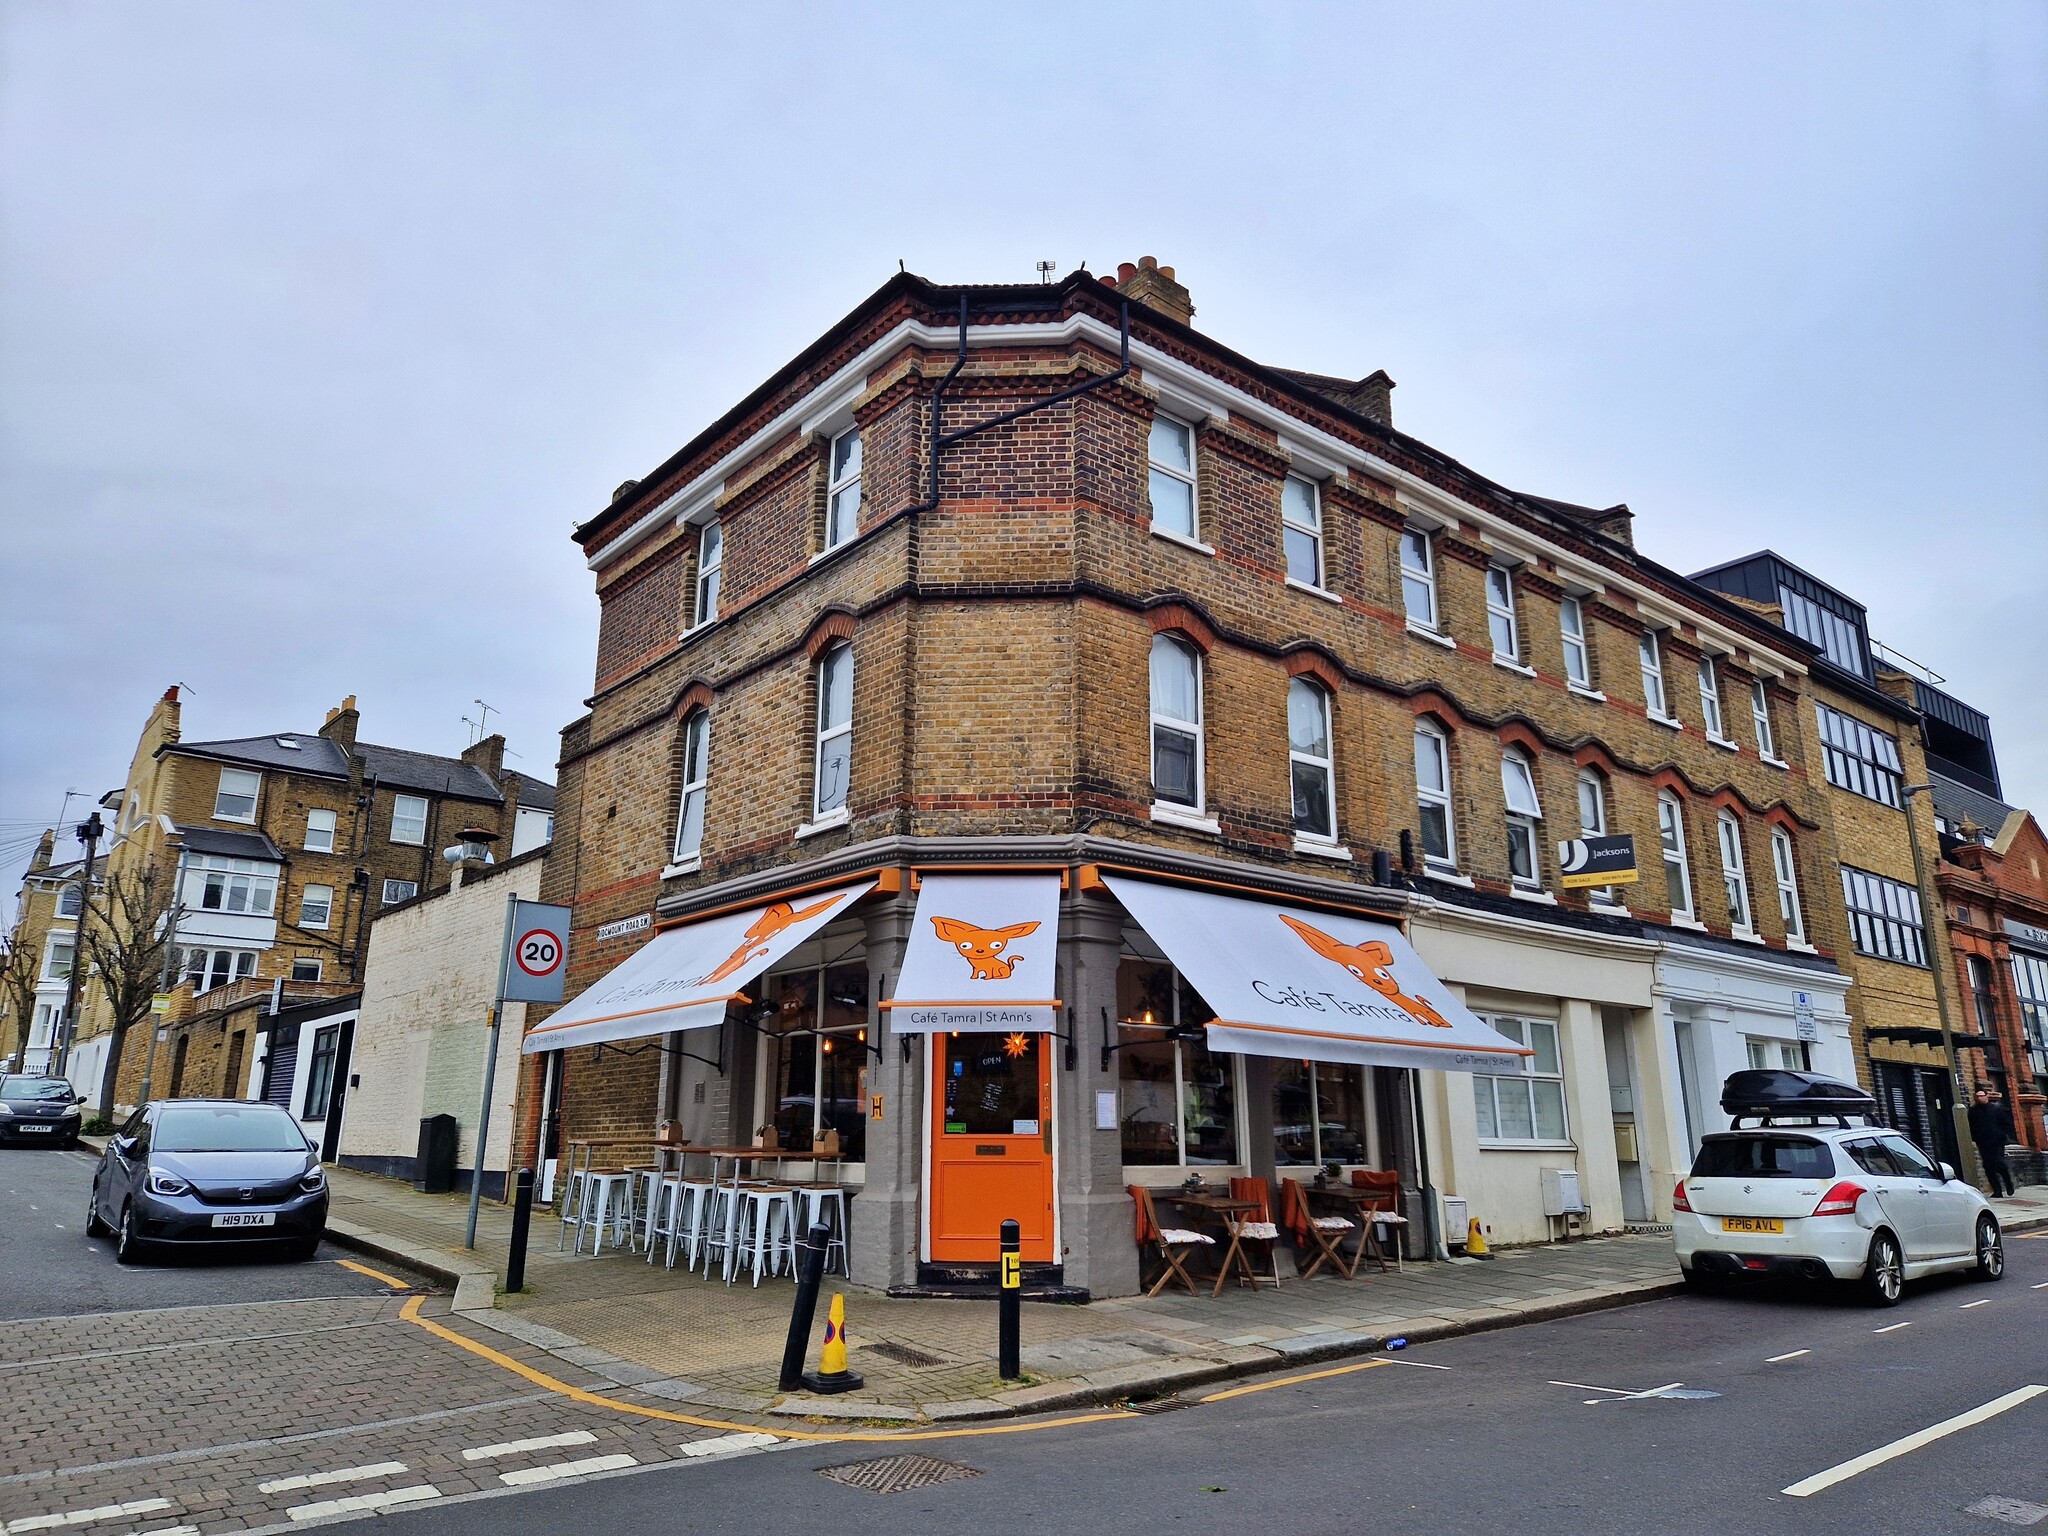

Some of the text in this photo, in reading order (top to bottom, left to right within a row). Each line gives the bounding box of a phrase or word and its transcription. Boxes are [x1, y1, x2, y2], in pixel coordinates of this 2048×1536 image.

[1593, 847, 1630, 859] Jacksons
[625, 919, 639, 931] ROAD
[525, 942, 555, 962] 20
[596, 983, 651, 1004] Café
[1252, 980, 1414, 1024] Café Tamra
[911, 1012, 938, 1023] Café
[941, 1012, 976, 1023] Tamra
[986, 1011, 997, 1022] St
[1000, 1011, 1033, 1022] Ann's
[983, 1056, 1001, 1065] OPEN
[222, 1215, 265, 1225] H19 DXA
[1728, 1218, 1777, 1231] FP16 AVL
